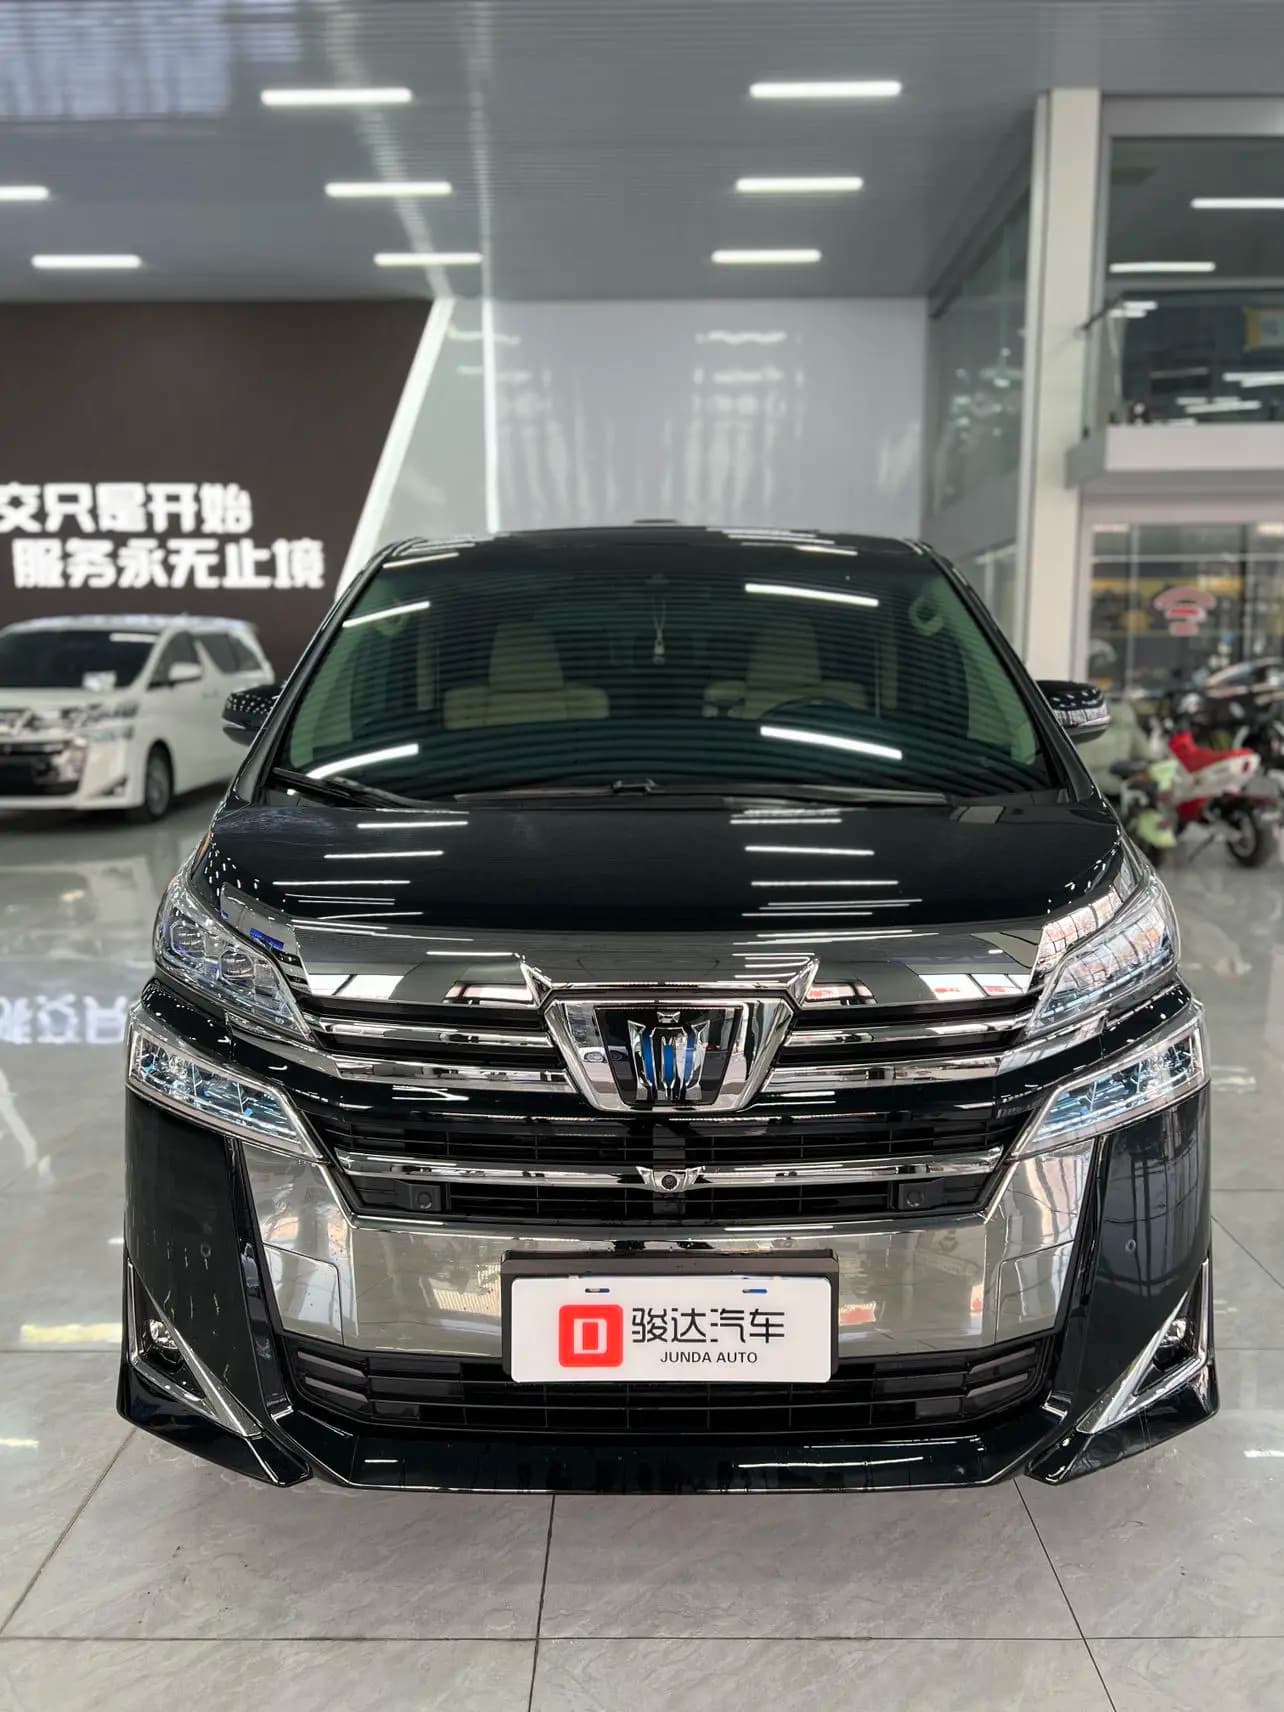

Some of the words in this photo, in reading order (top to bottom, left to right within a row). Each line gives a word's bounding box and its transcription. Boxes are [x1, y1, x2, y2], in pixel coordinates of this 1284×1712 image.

[12, 537, 325, 589] 服务永无止境
[631, 1307, 785, 1344] 骏达汽车
[660, 1351, 712, 1364] JUNDA
[716, 1351, 758, 1364] AUTO
